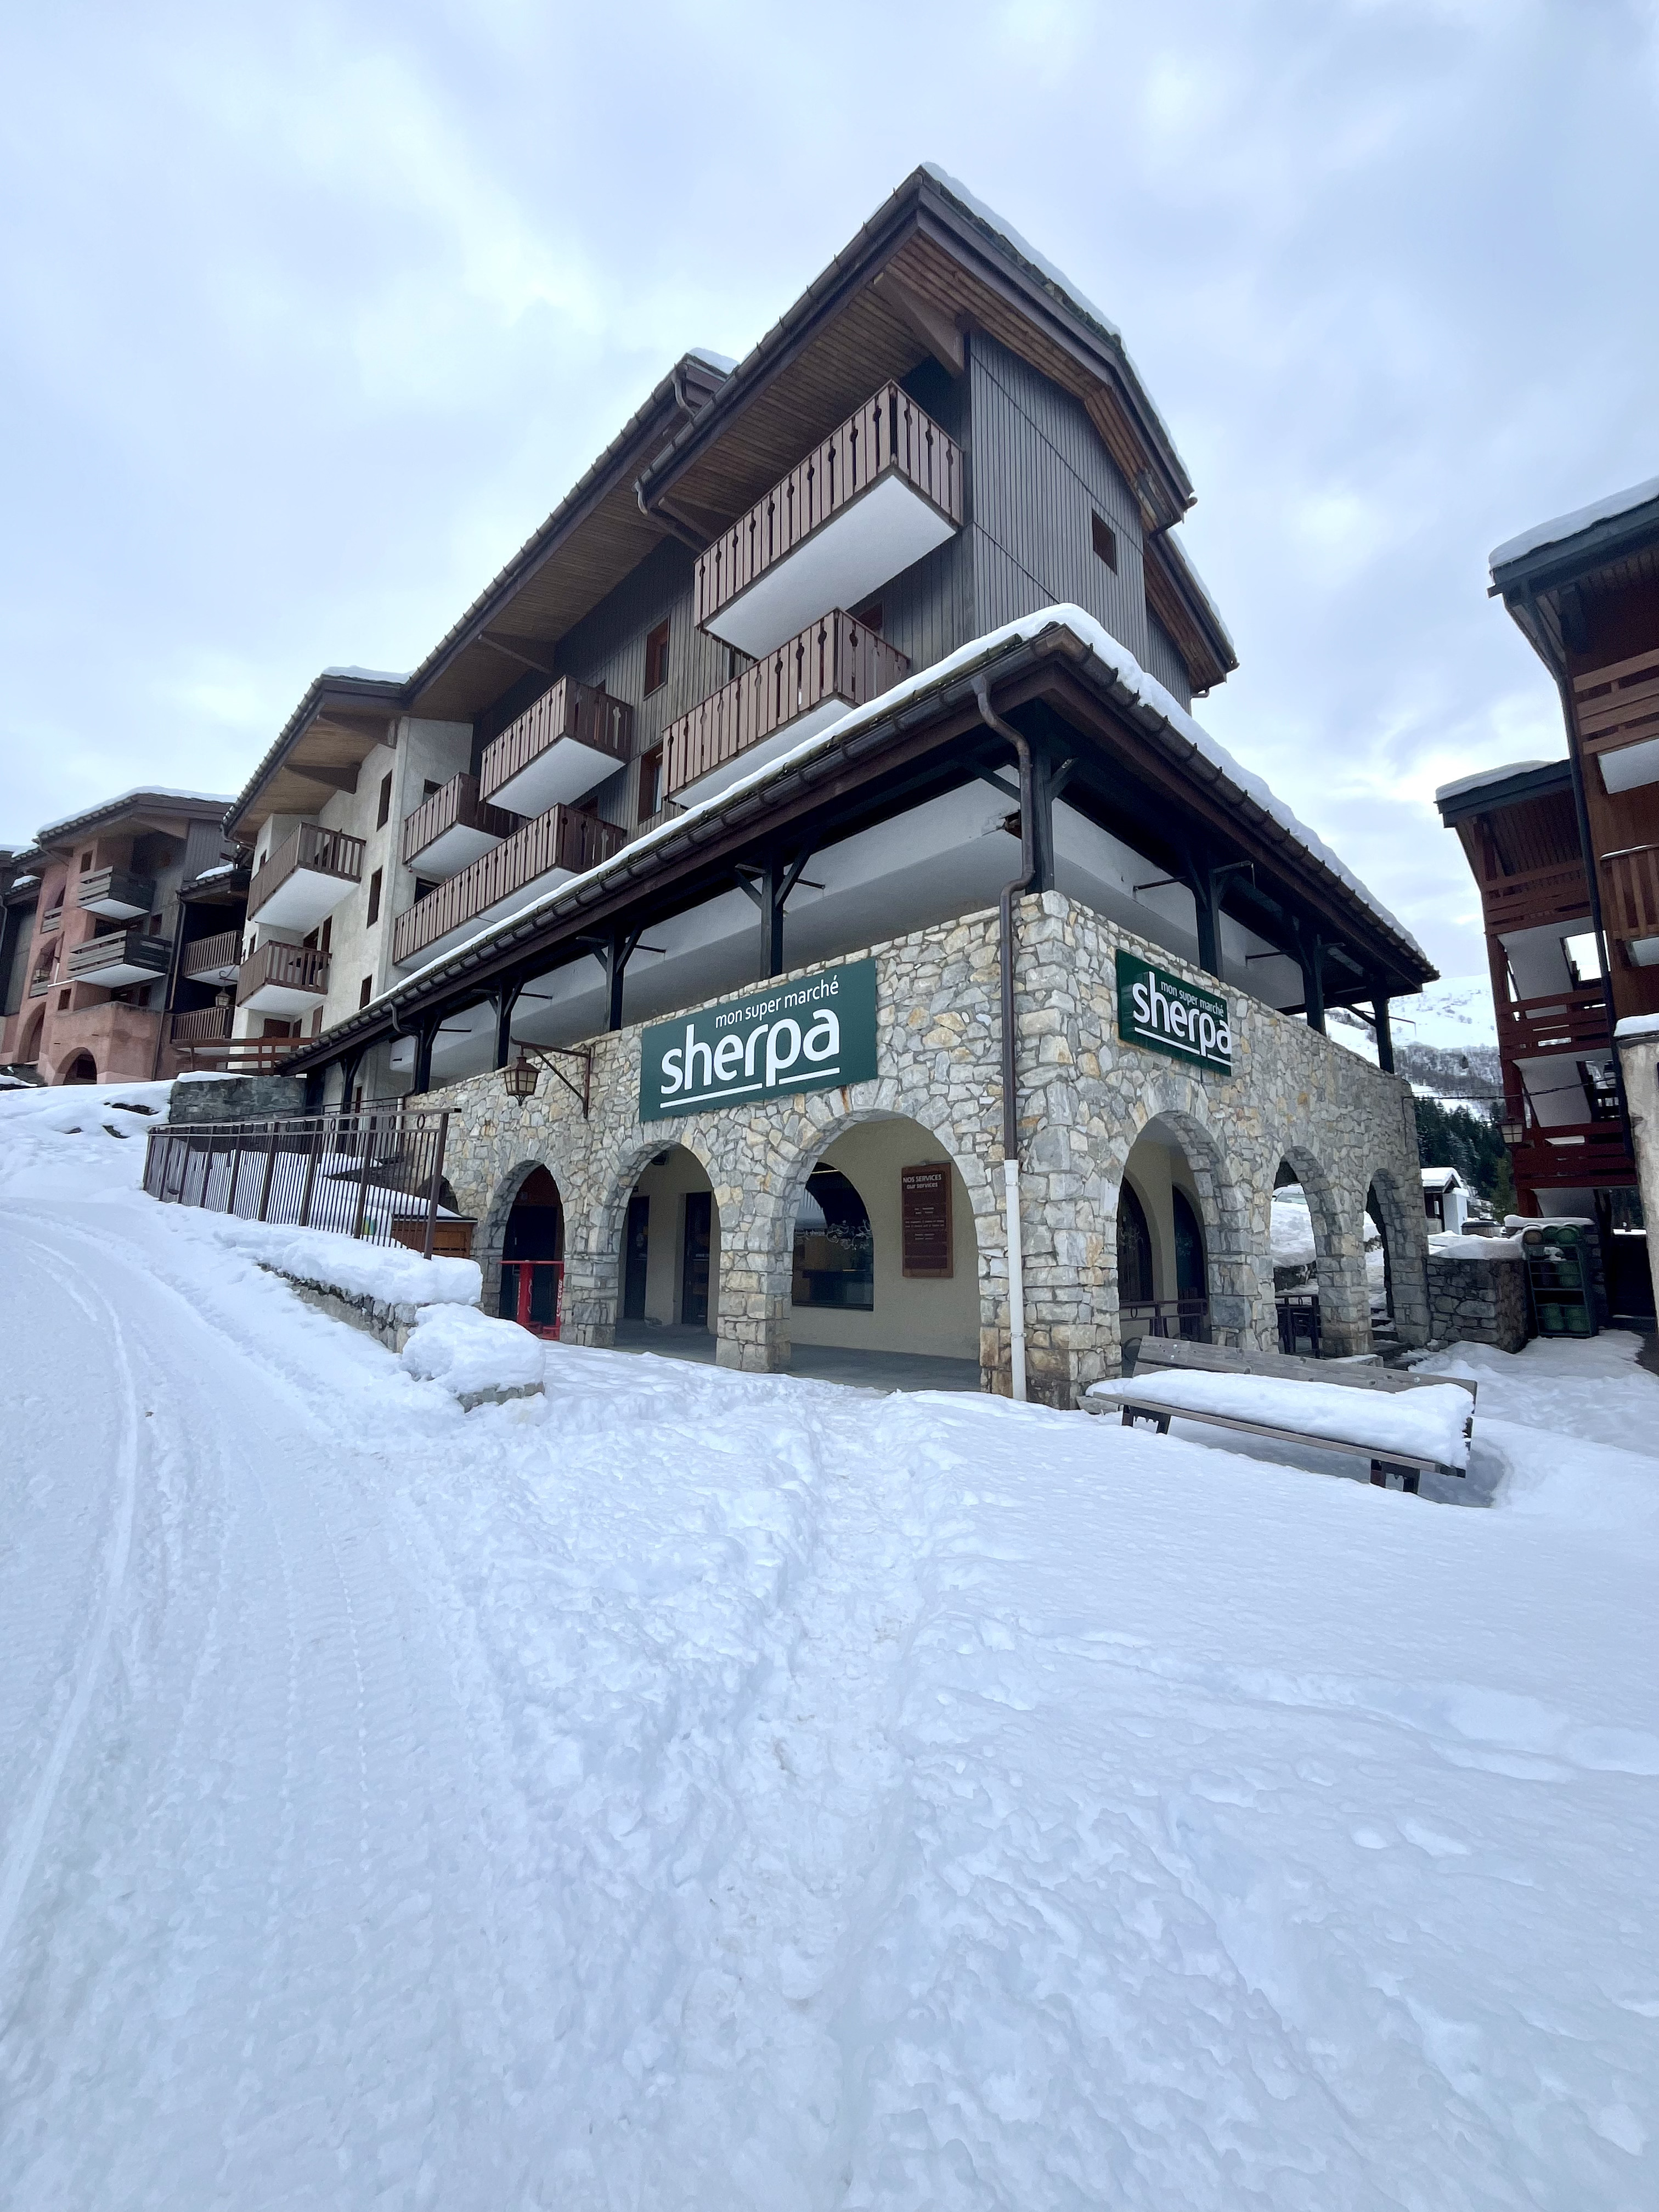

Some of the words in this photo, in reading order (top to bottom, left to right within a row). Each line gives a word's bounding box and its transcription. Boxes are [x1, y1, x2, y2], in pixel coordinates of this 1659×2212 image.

[715, 1010, 742, 1029] mon
[745, 996, 782, 1022] super
[785, 974, 839, 1008] marché
[1132, 971, 1232, 1057] sherpa
[1160, 981, 1178, 996] mon
[1179, 990, 1198, 1007] super
[1199, 999, 1224, 1017] marché
[661, 1008, 840, 1094] sherpa
[915, 1173, 942, 1182] SERVICES
